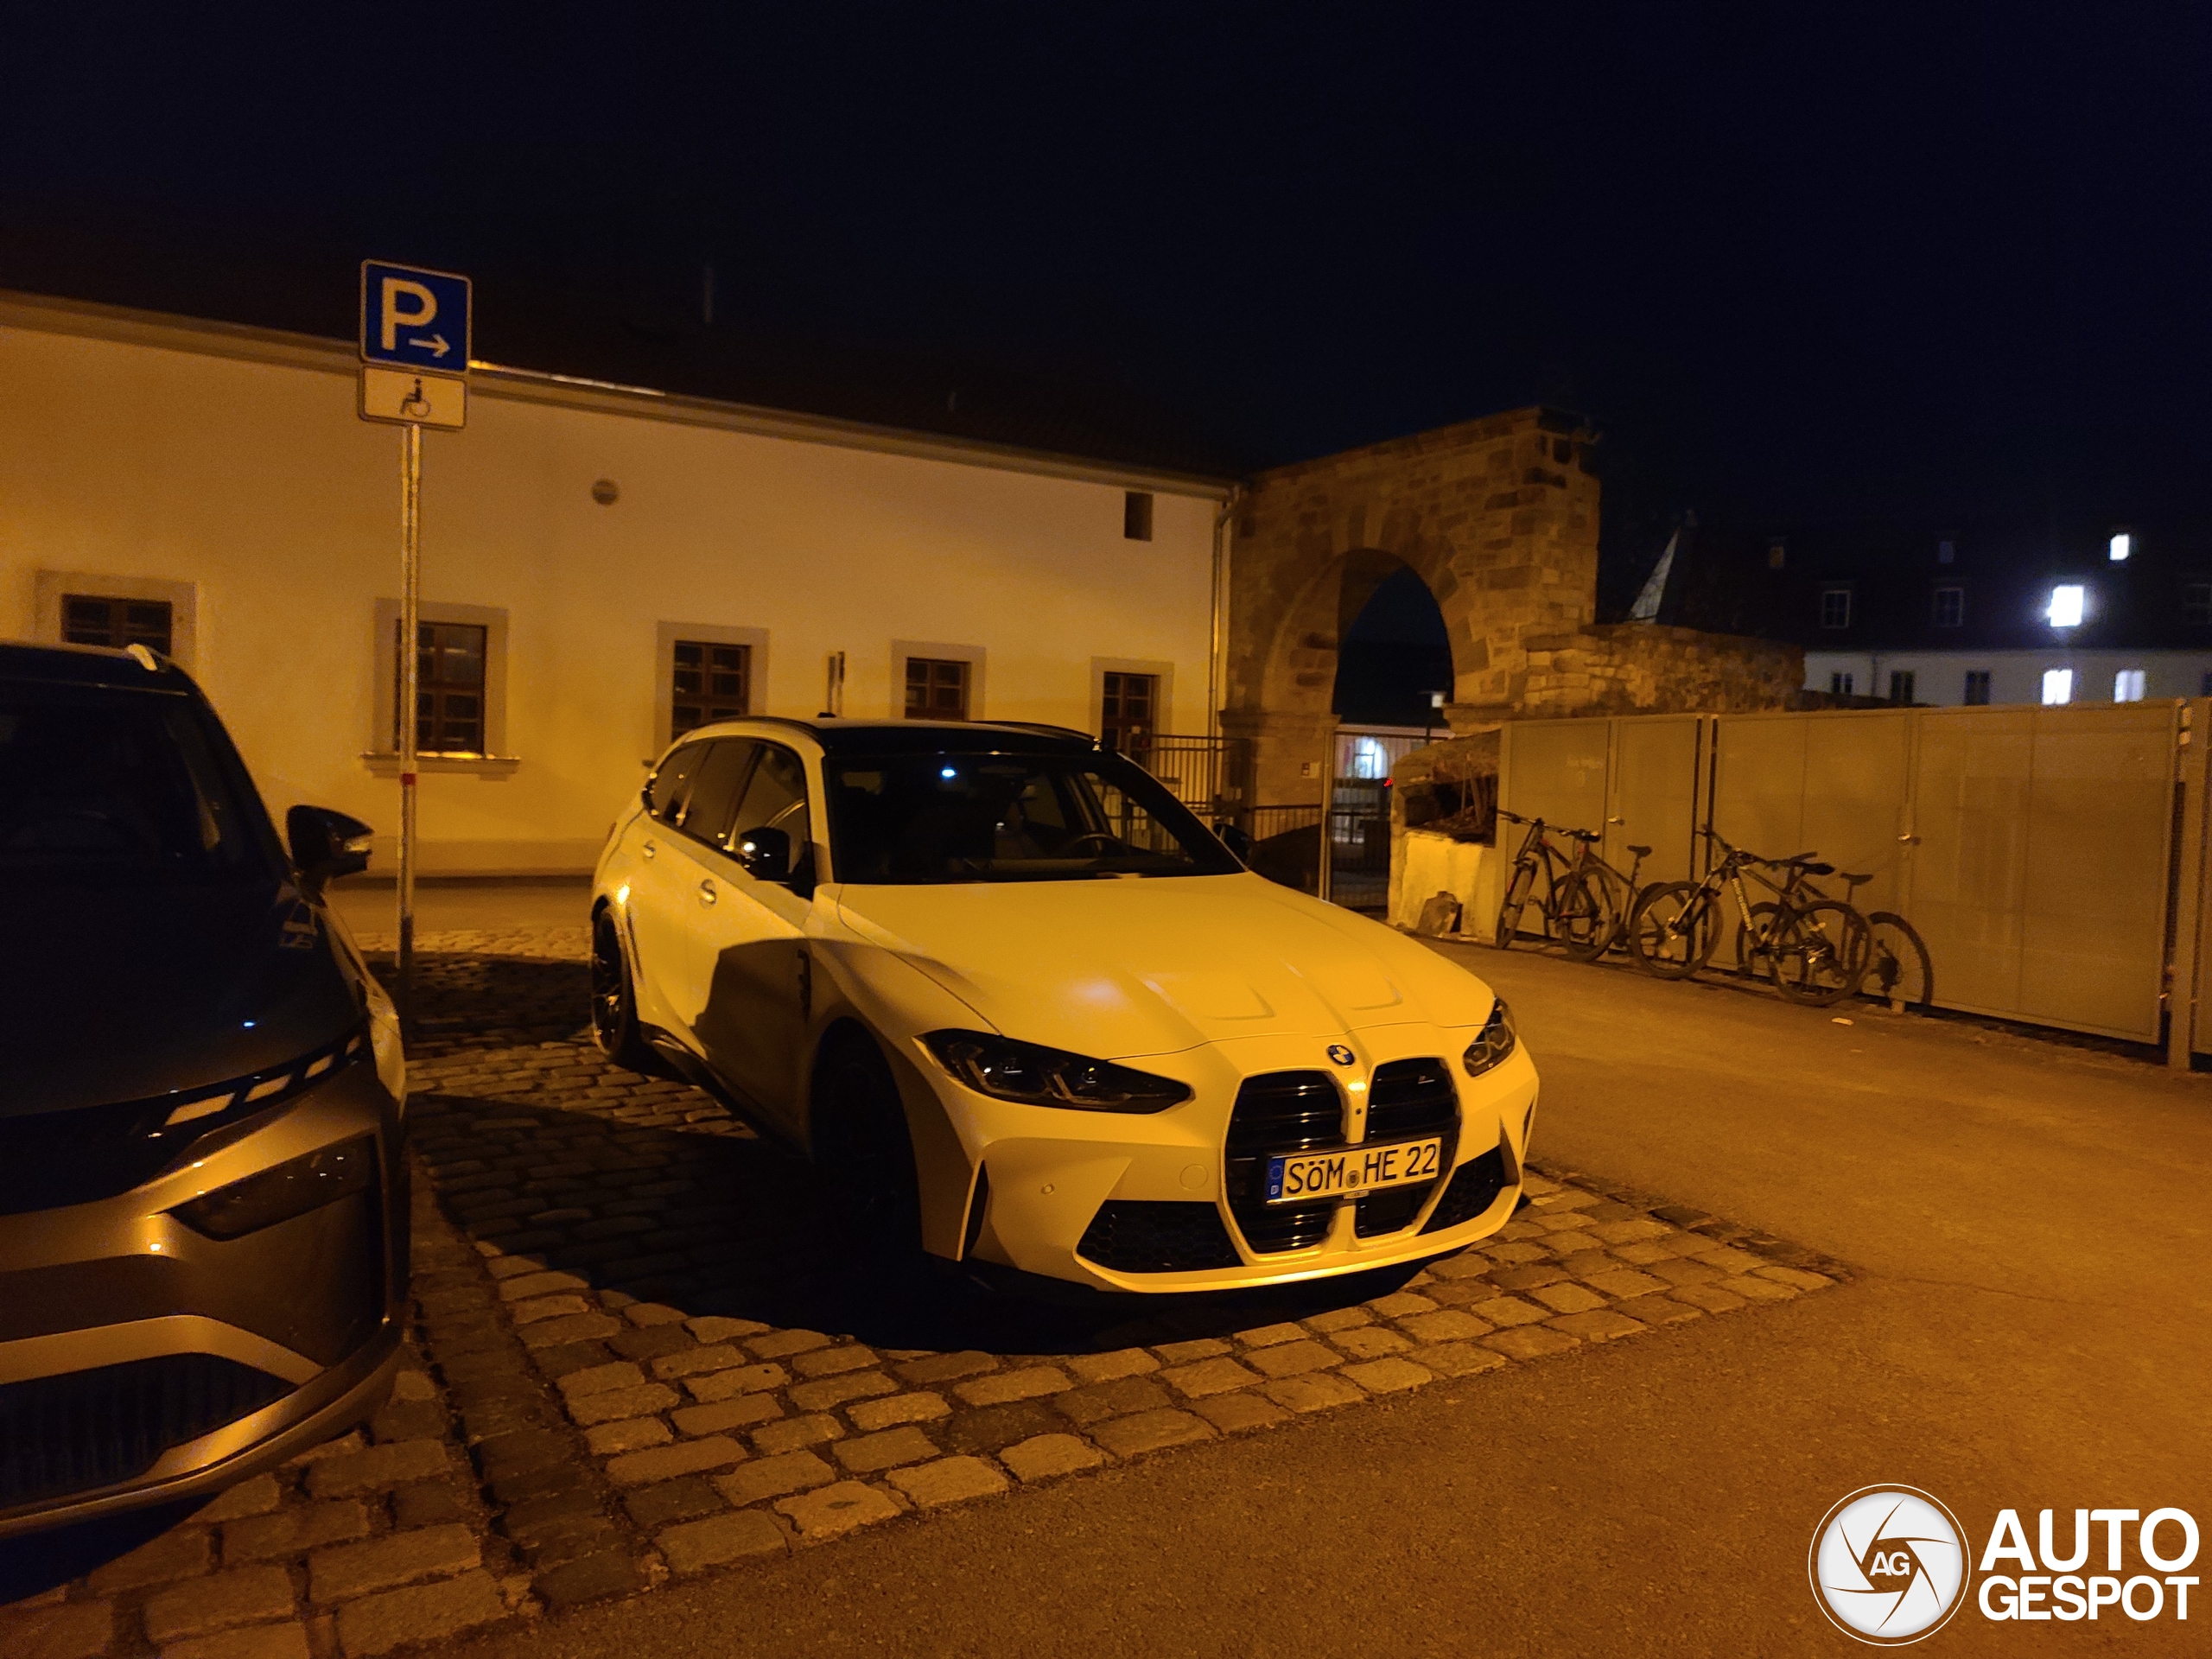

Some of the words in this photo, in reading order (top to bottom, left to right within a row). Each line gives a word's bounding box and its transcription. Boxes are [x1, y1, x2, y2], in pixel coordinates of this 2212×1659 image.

[381, 276, 438, 351] P
[1286, 1157, 1344, 1194] SÖM
[1363, 1150, 1398, 1184] HE
[1405, 1143, 1438, 1178] 22
